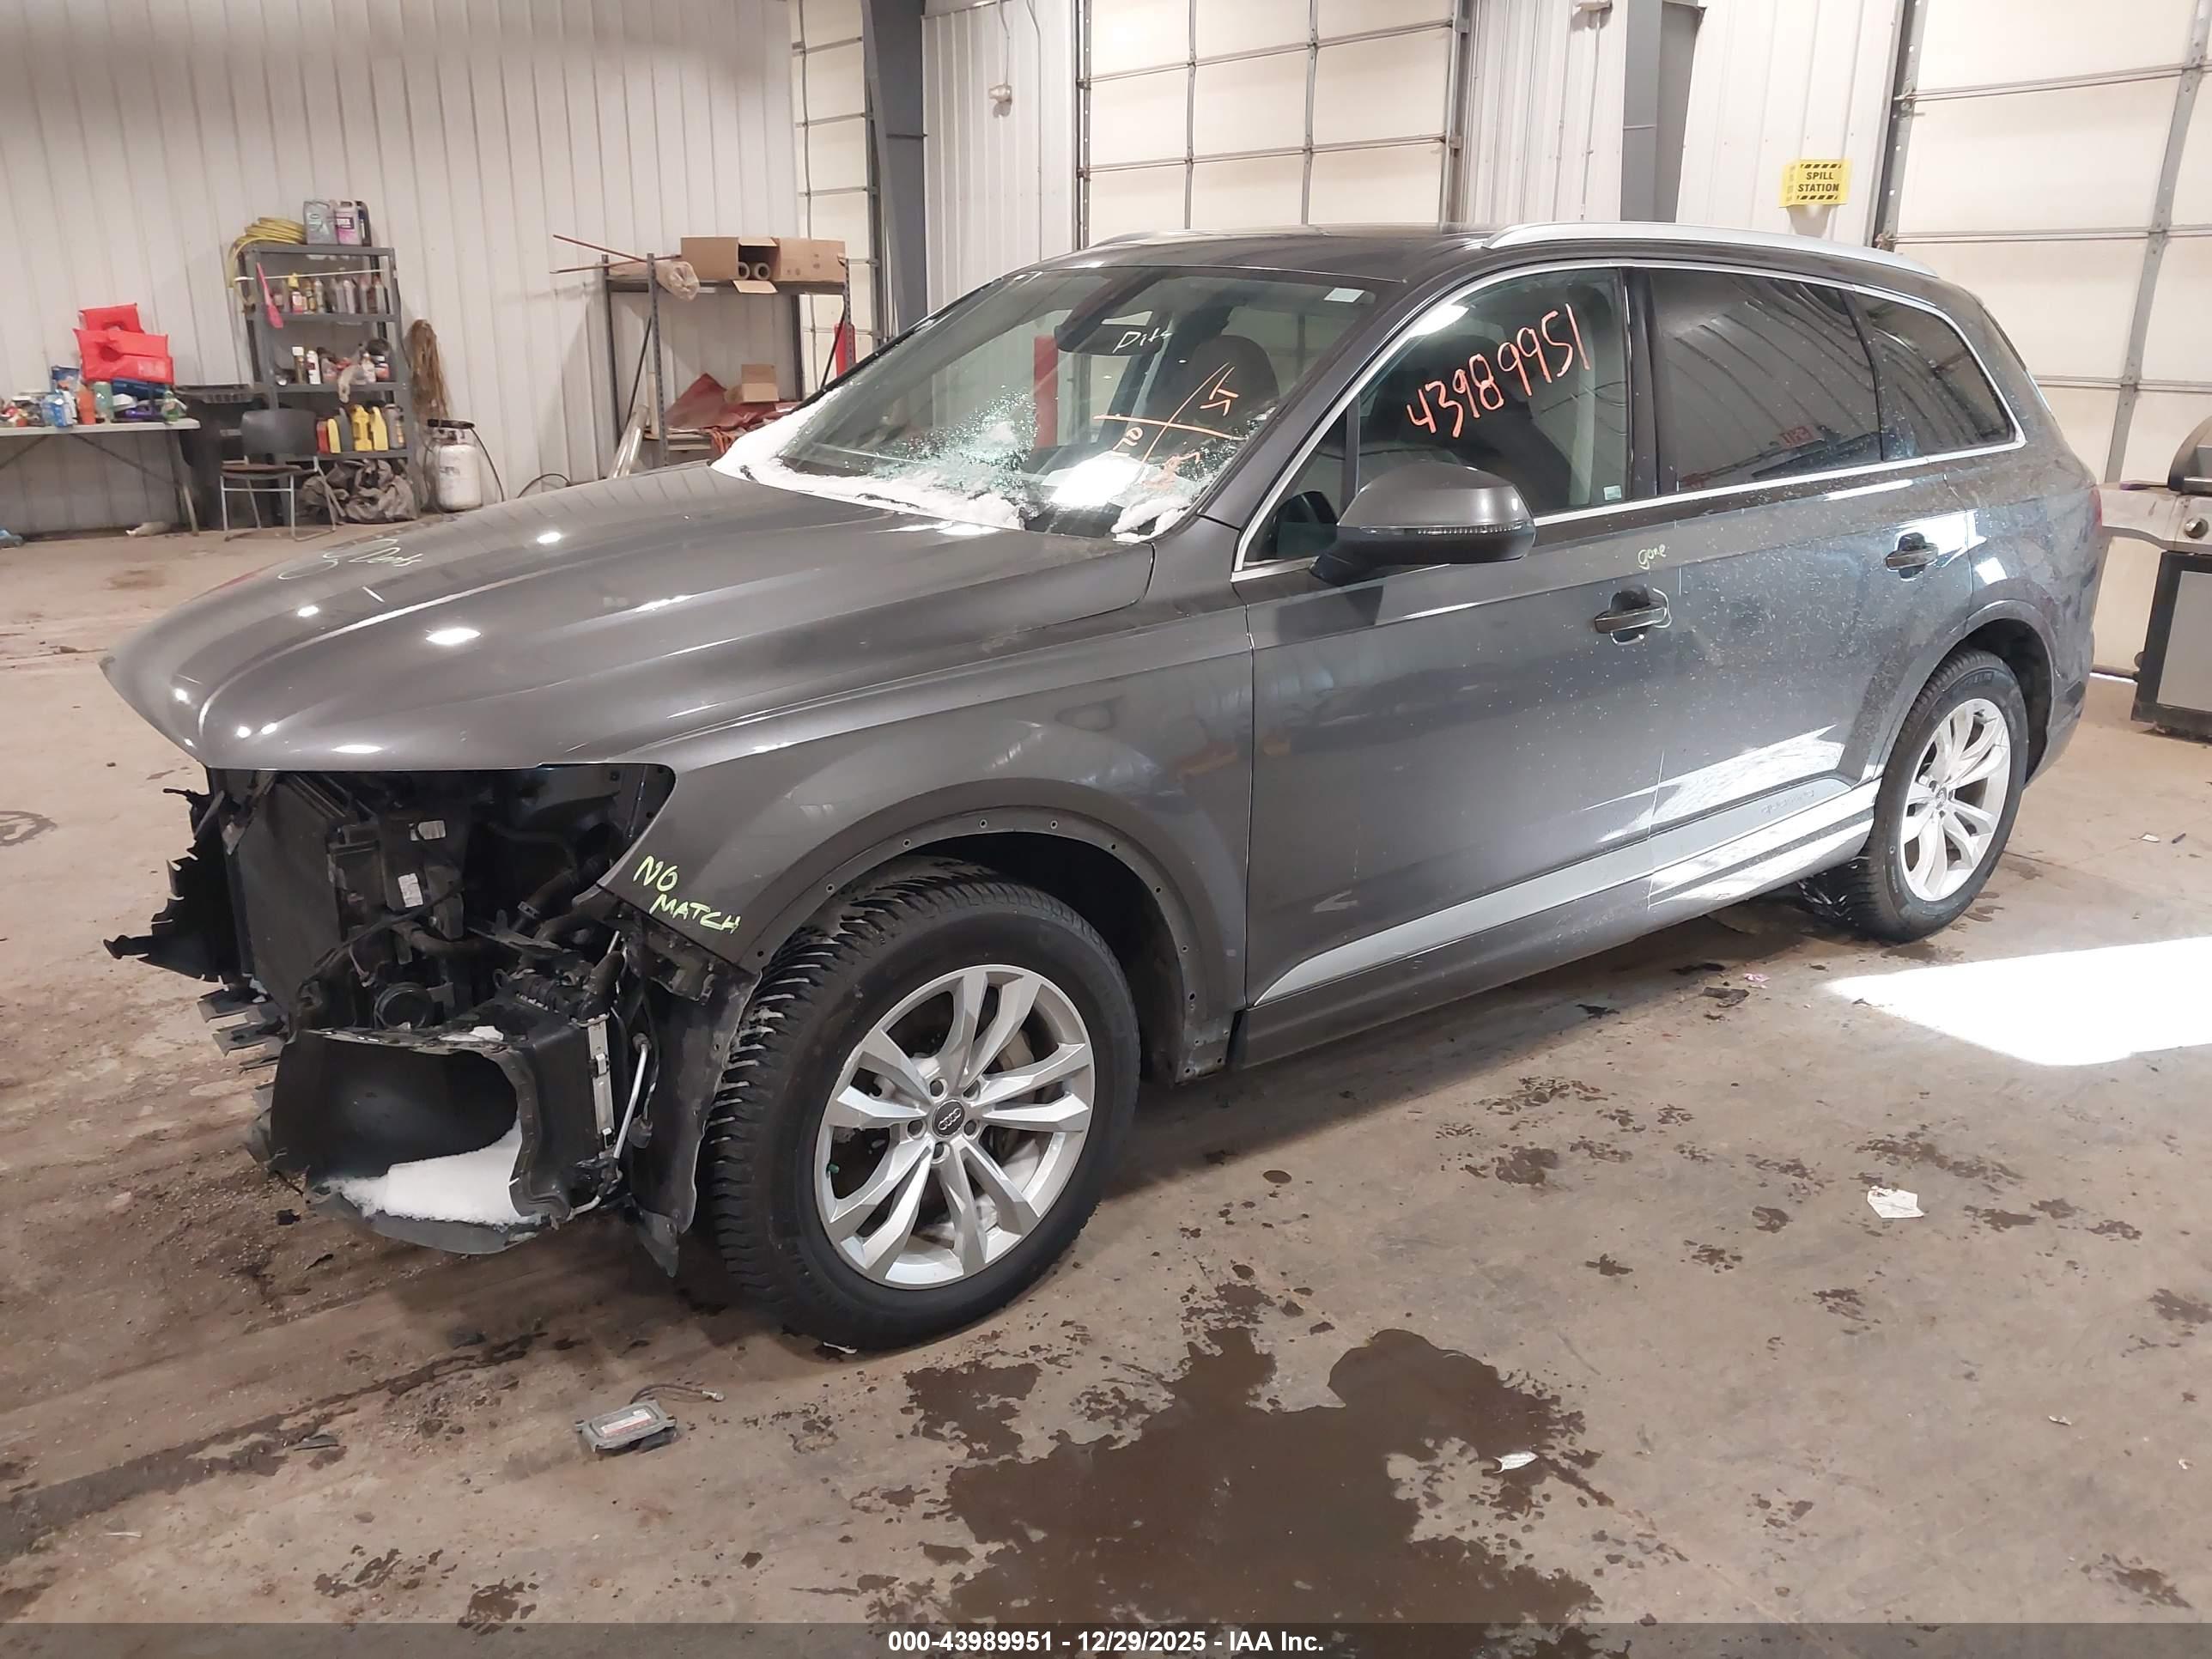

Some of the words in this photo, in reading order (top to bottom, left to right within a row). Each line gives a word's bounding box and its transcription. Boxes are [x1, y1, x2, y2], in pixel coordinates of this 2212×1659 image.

[1797, 183, 1840, 192] STATION
[1806, 171, 1834, 180] SPILL
[1406, 302, 1590, 438] 43989951
[1638, 543, 1667, 570] gone
[633, 855, 678, 892] NO
[648, 893, 741, 934] MATCH
